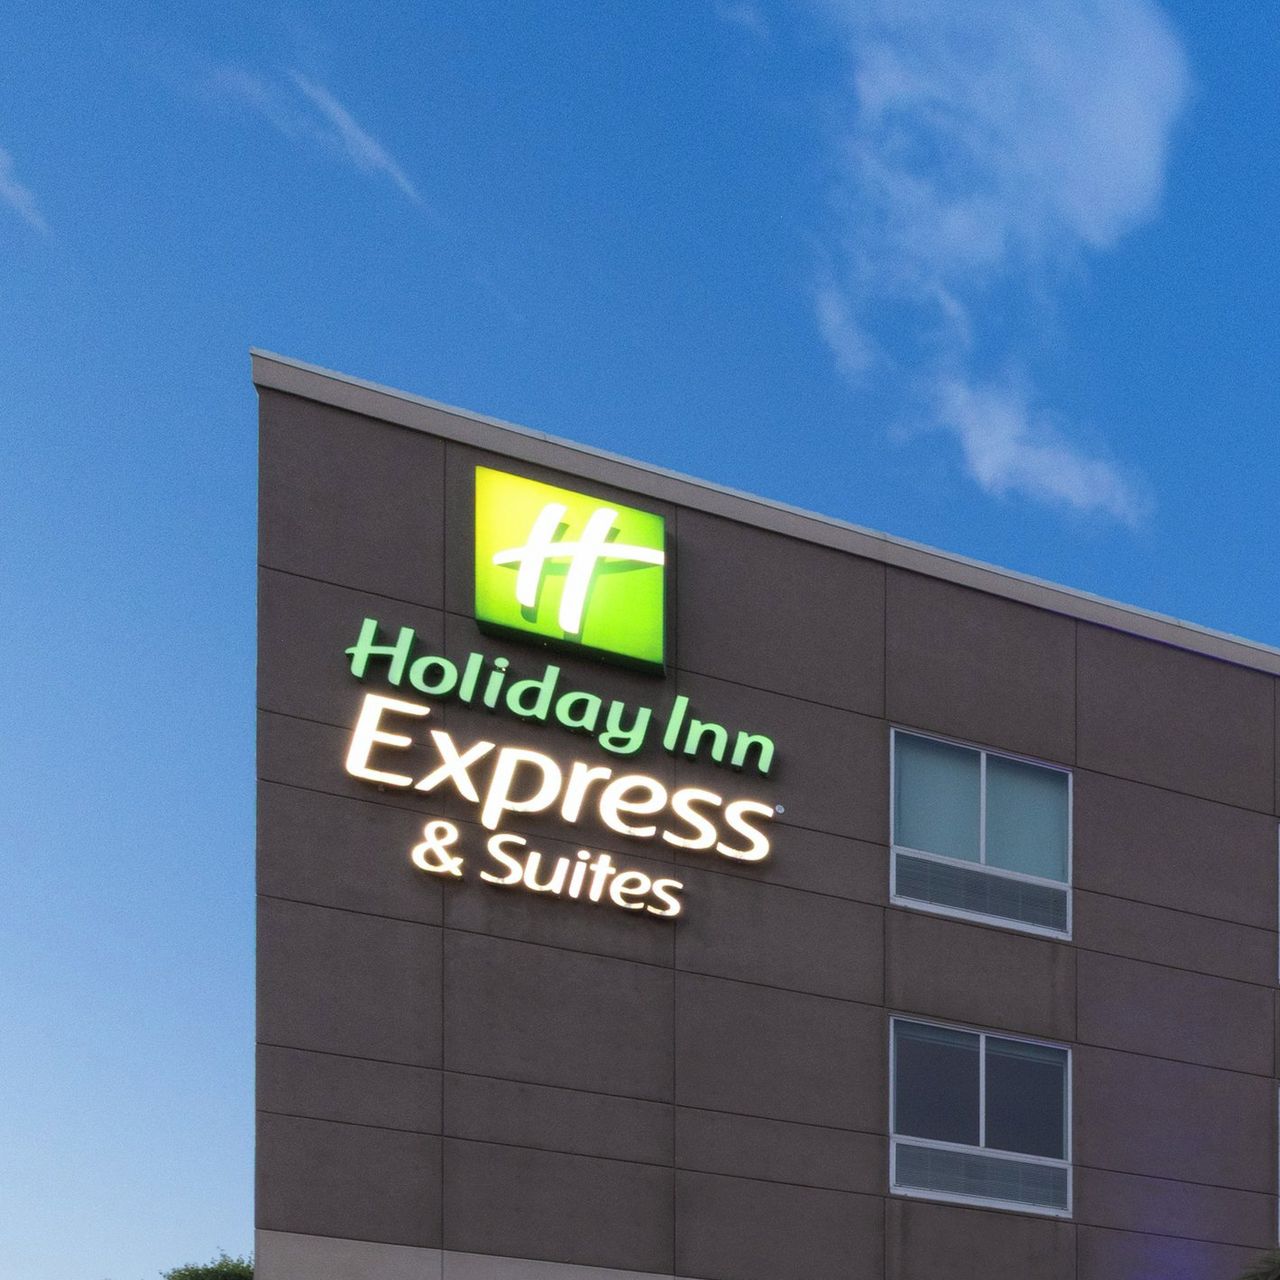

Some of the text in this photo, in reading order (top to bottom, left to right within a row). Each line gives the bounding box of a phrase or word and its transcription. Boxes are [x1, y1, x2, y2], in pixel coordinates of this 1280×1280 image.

[345, 618, 776, 774] Holiday Inn
[345, 693, 776, 863] Express
[411, 820, 685, 917] & Suites
